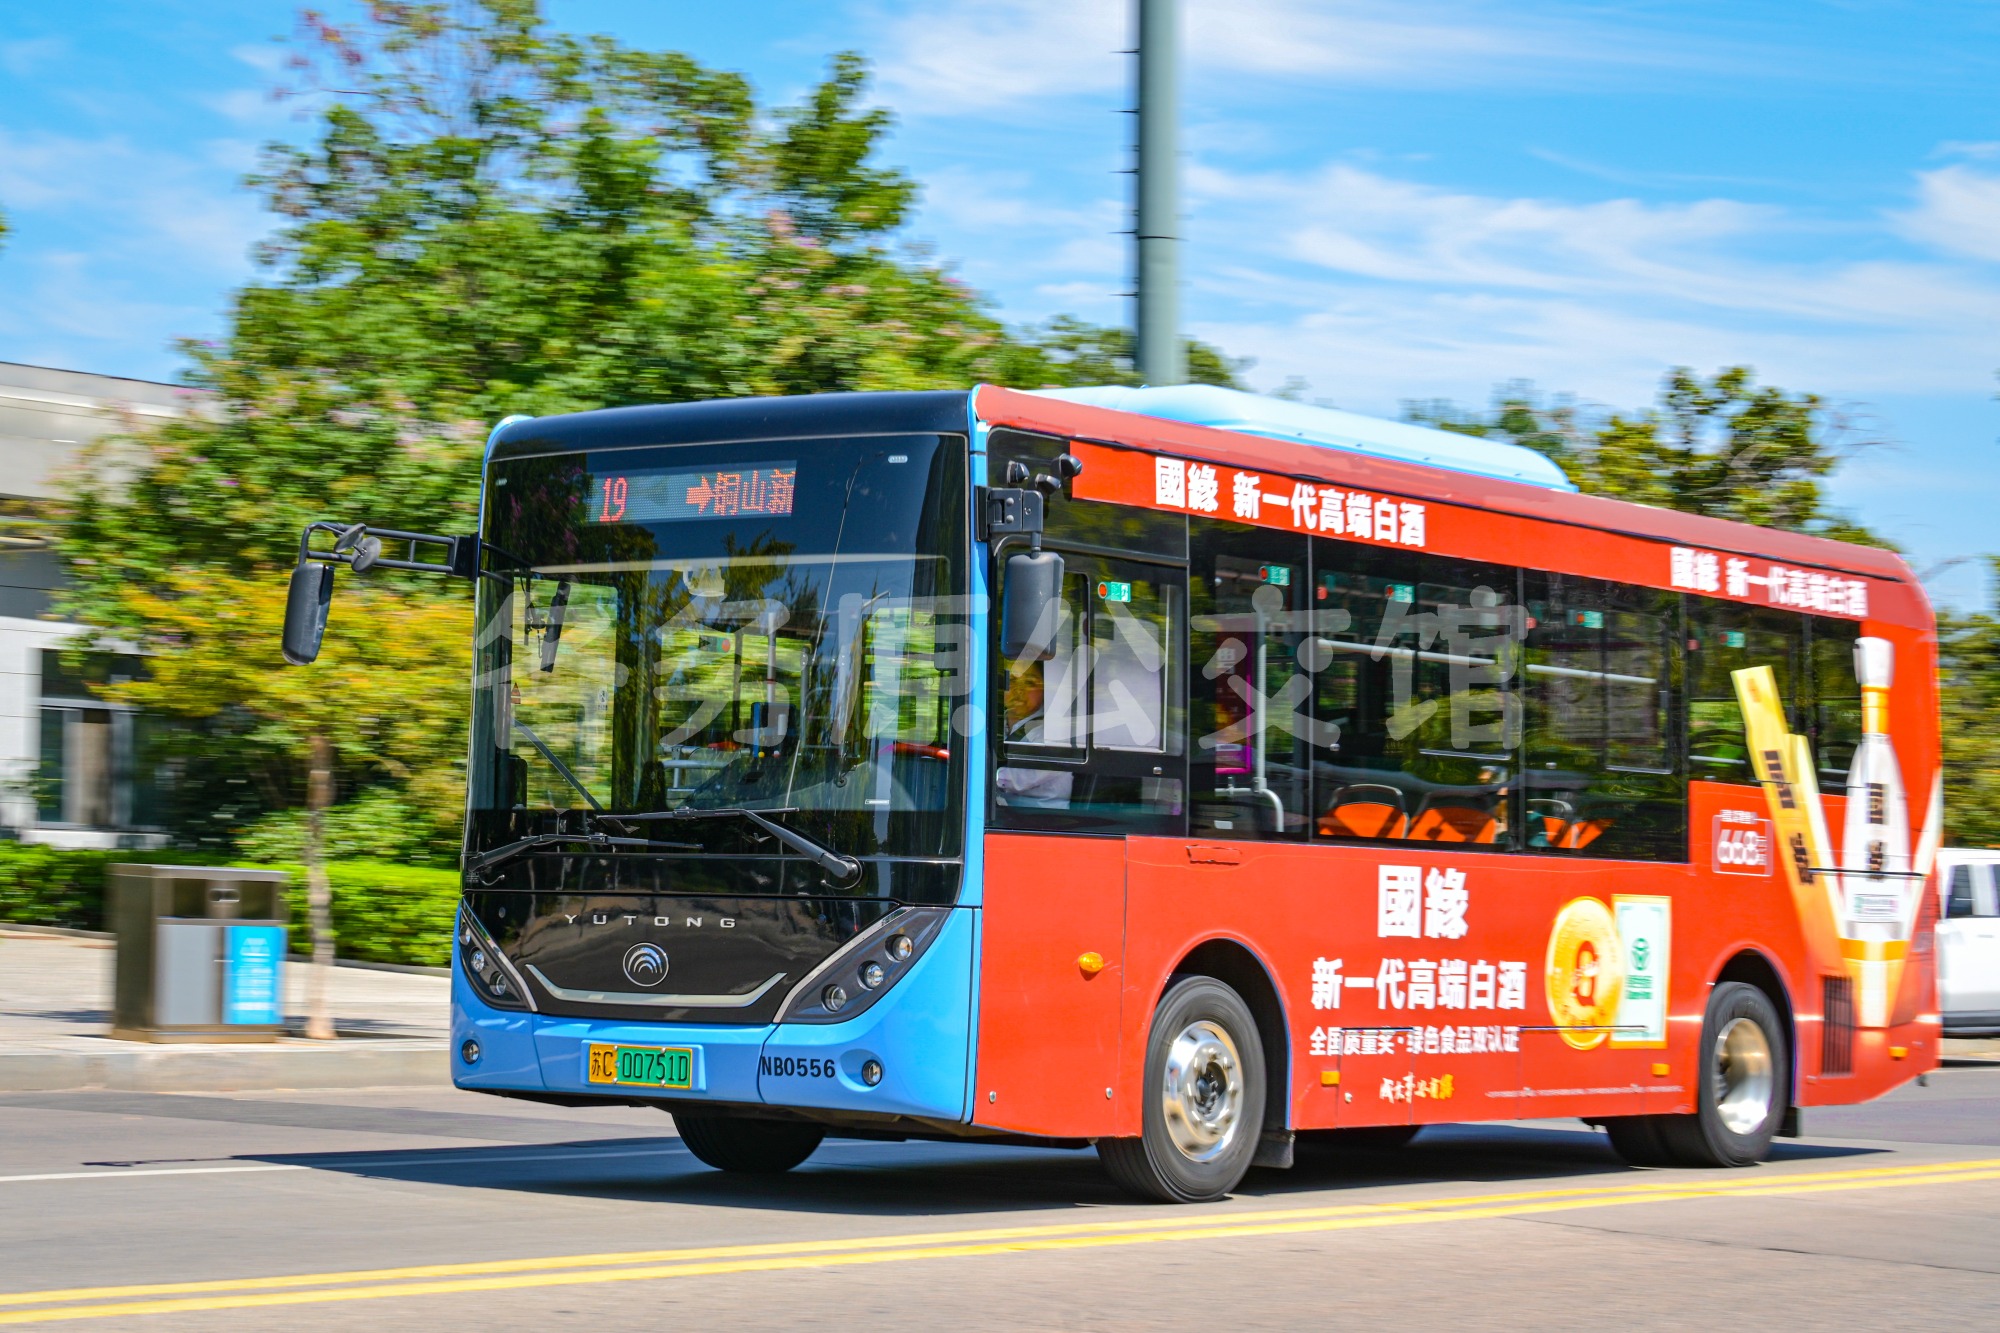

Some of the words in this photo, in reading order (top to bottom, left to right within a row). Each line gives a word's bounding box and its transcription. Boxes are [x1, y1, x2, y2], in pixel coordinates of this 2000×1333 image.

[599, 477, 628, 522] 19
[1233, 472, 1426, 547] 新一代高端白酒
[565, 914, 736, 928] YUTONG
[1378, 865, 1469, 939] 國緣
[1311, 957, 1526, 1010] 新一代高端白酒
[760, 1056, 836, 1078] NB0556
